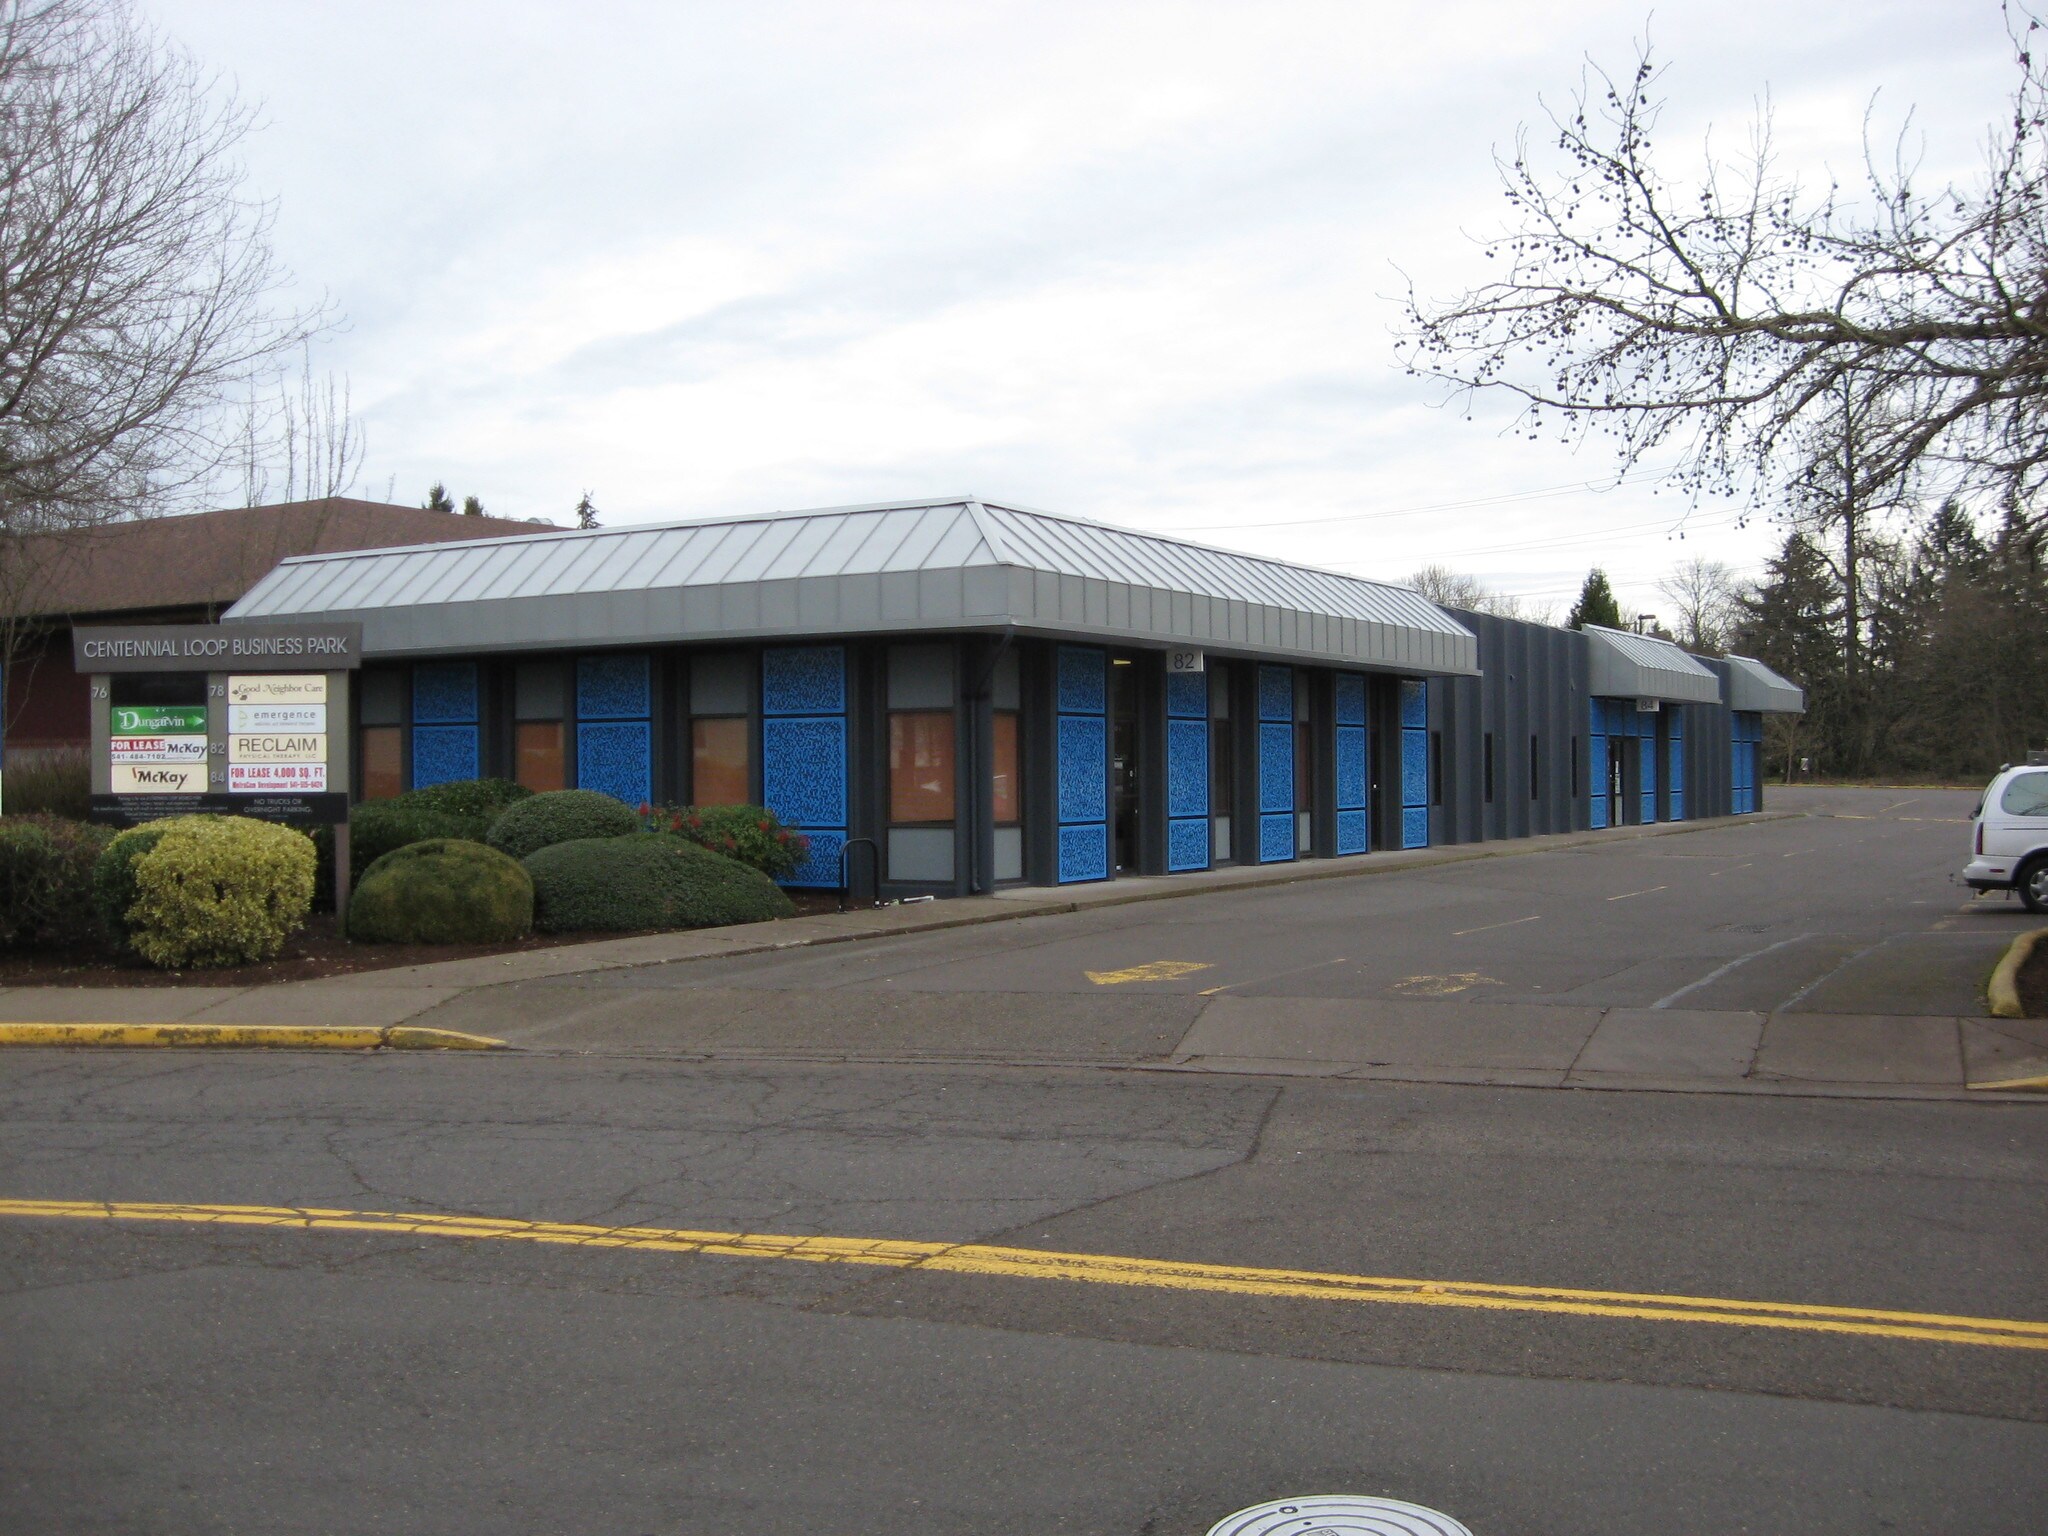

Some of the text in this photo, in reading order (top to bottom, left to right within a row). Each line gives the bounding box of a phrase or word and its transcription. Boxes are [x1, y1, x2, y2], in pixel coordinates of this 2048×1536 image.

[84, 637, 347, 658] CENTENNIAL LOOP BUSINESS PARK
[1174, 653, 1194, 669] 82
[93, 687, 107, 699] 76
[210, 685, 224, 697] 78
[238, 683, 323, 695] Good Neighbor Care
[1641, 702, 1654, 710] 84
[118, 711, 184, 730] Dungarvin
[253, 711, 316, 720] emergence
[111, 740, 165, 750] FOR LEASE
[167, 743, 207, 759] McKay
[211, 743, 225, 755] 82
[239, 738, 317, 752] RECLAIM
[211, 771, 225, 783] 84
[231, 767, 325, 779] FOR LEASE 4,000 SQ. FT.
[138, 770, 188, 790] McKay
